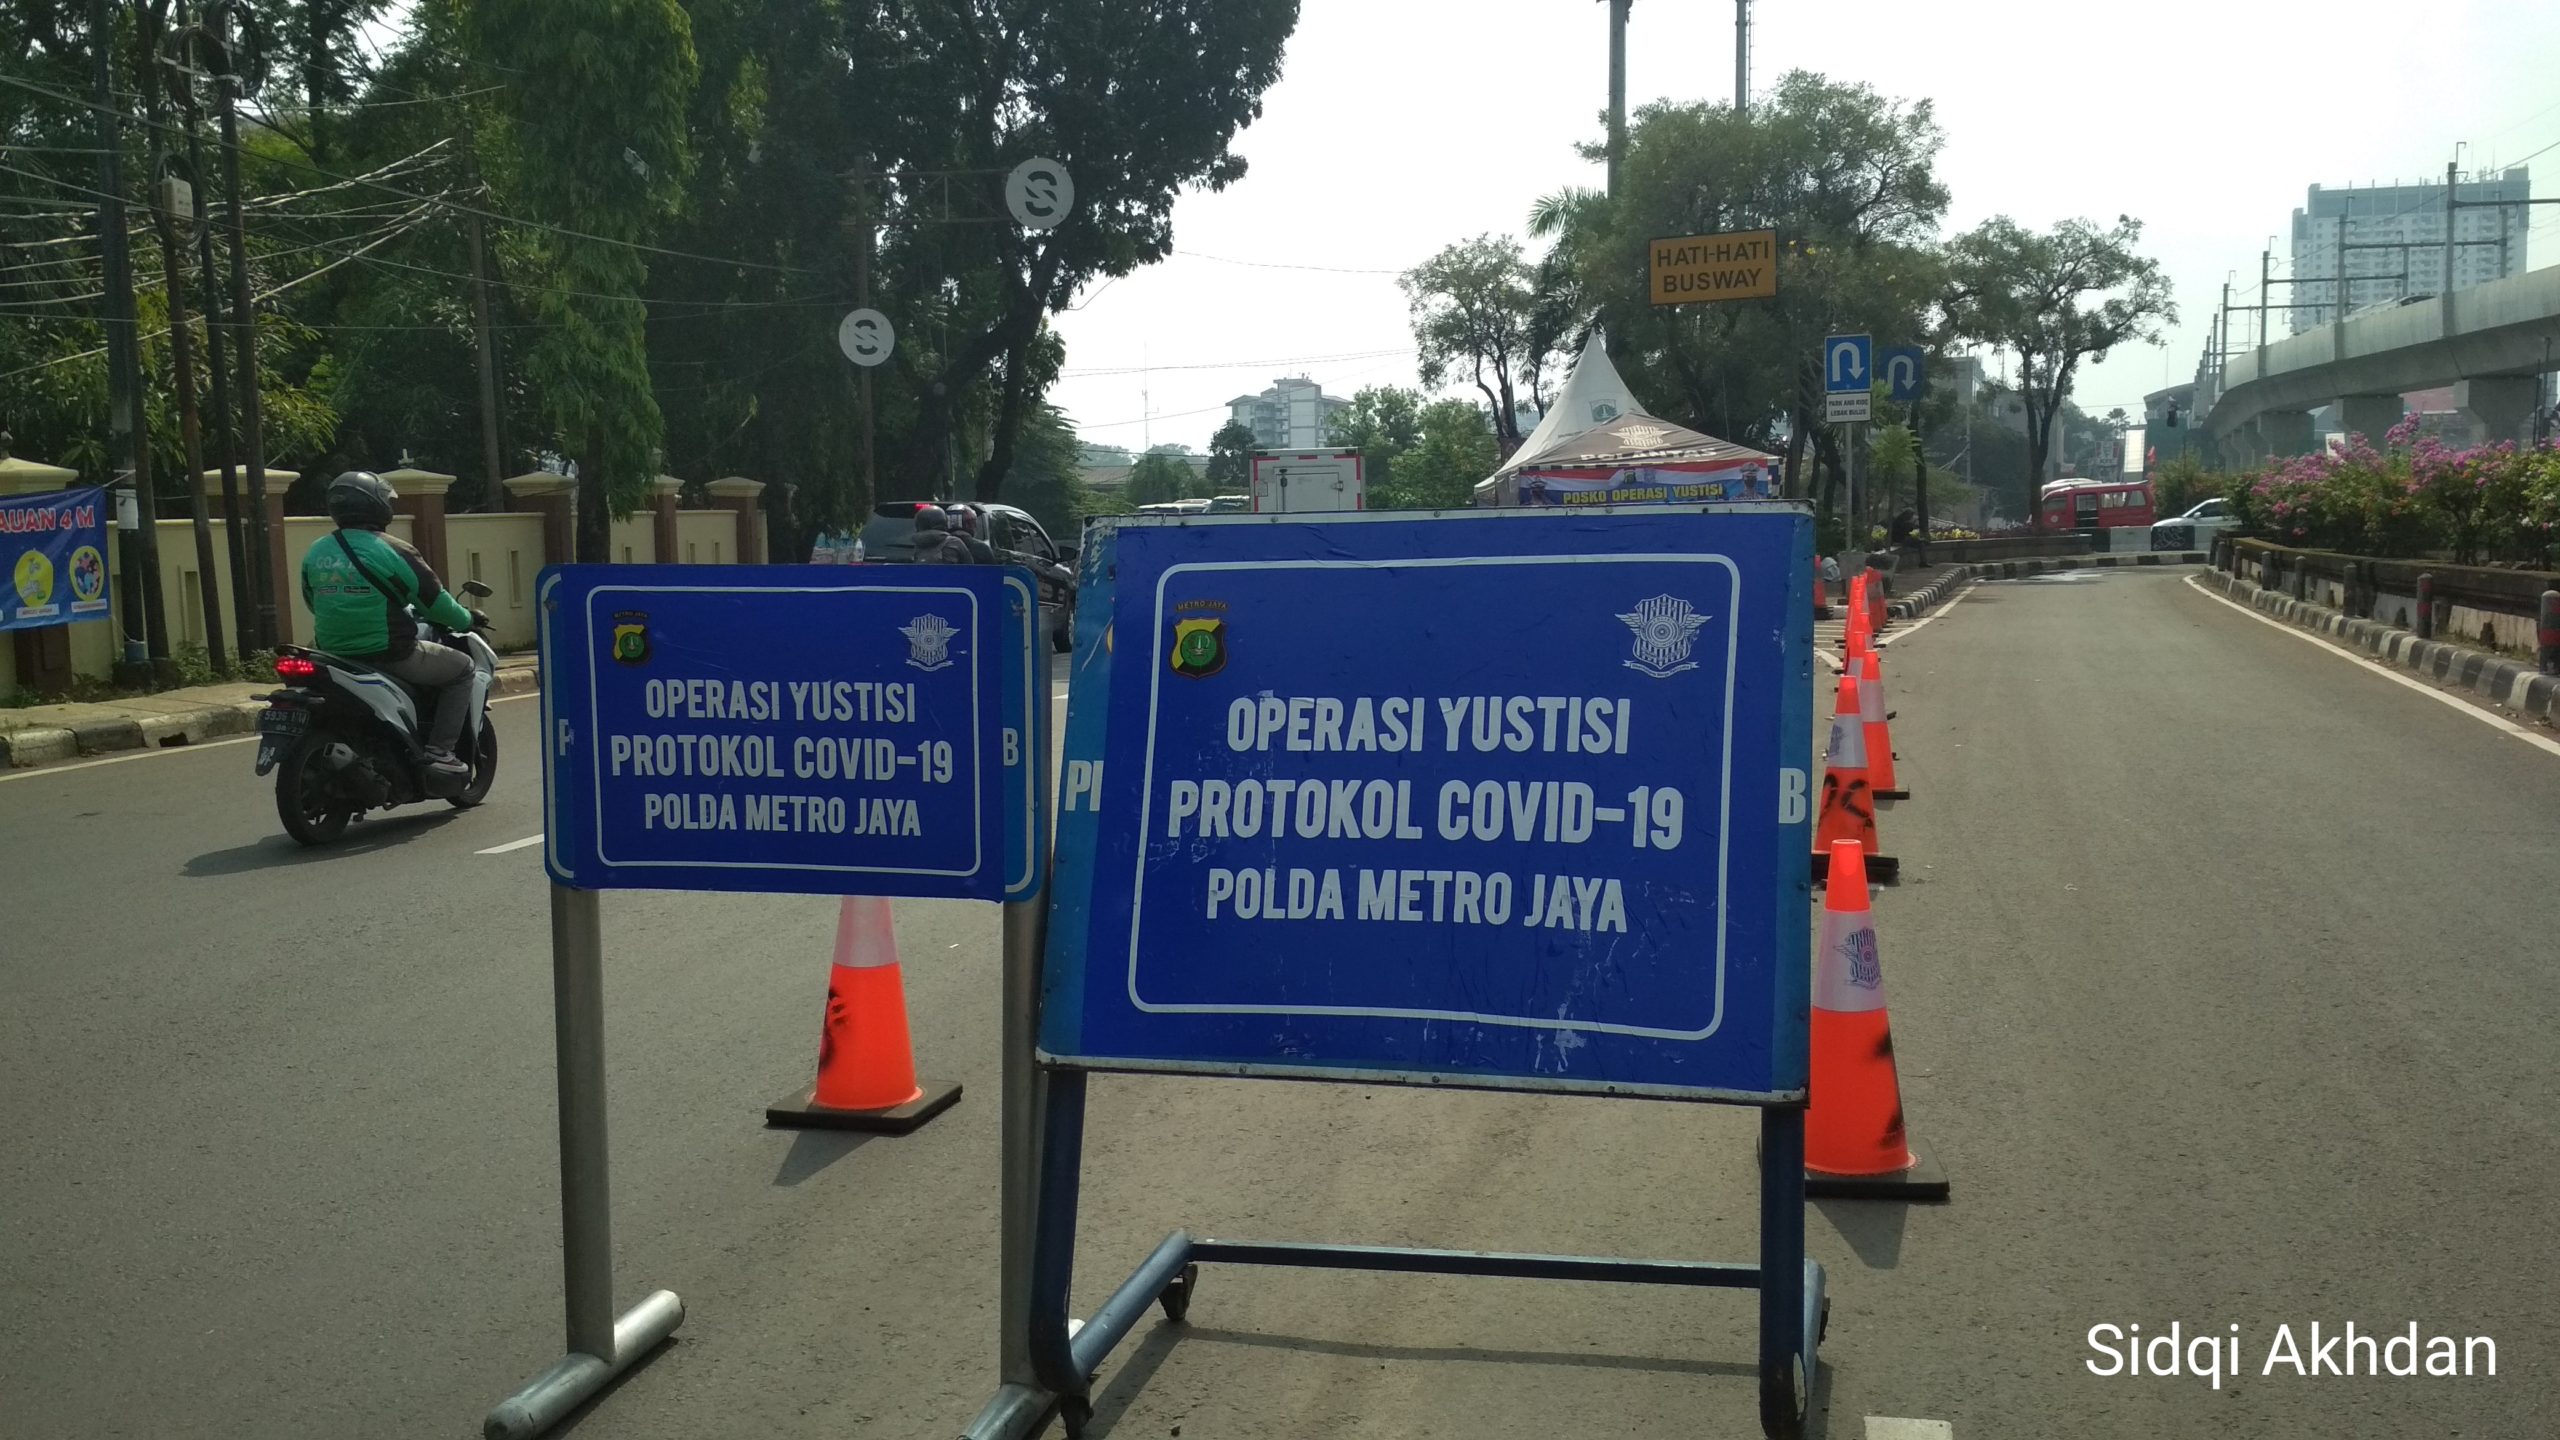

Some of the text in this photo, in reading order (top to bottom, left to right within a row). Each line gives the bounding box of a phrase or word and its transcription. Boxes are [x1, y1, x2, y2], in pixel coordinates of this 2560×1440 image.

[1656, 241, 1770, 268] HATI-HATI
[1663, 267, 1763, 293] BUSWAY
[1562, 483, 1724, 504] POSKO OPERASI YUSTISI
[60, 508, 73, 530] 4
[75, 505, 95, 529] M
[1177, 600, 1228, 610] METRO JAYA
[645, 678, 916, 723] OPERASI YUSTISI
[1227, 695, 1631, 755] OPERASI YUSTISI
[610, 734, 953, 784] PROTOKOL COVID-19
[644, 792, 922, 837] POLDA METRO JAYA
[1167, 778, 1684, 850] PROTOKOL COVID-19
[1779, 767, 1807, 824] B
[1206, 867, 1628, 933] POLDA METRO JAYA
